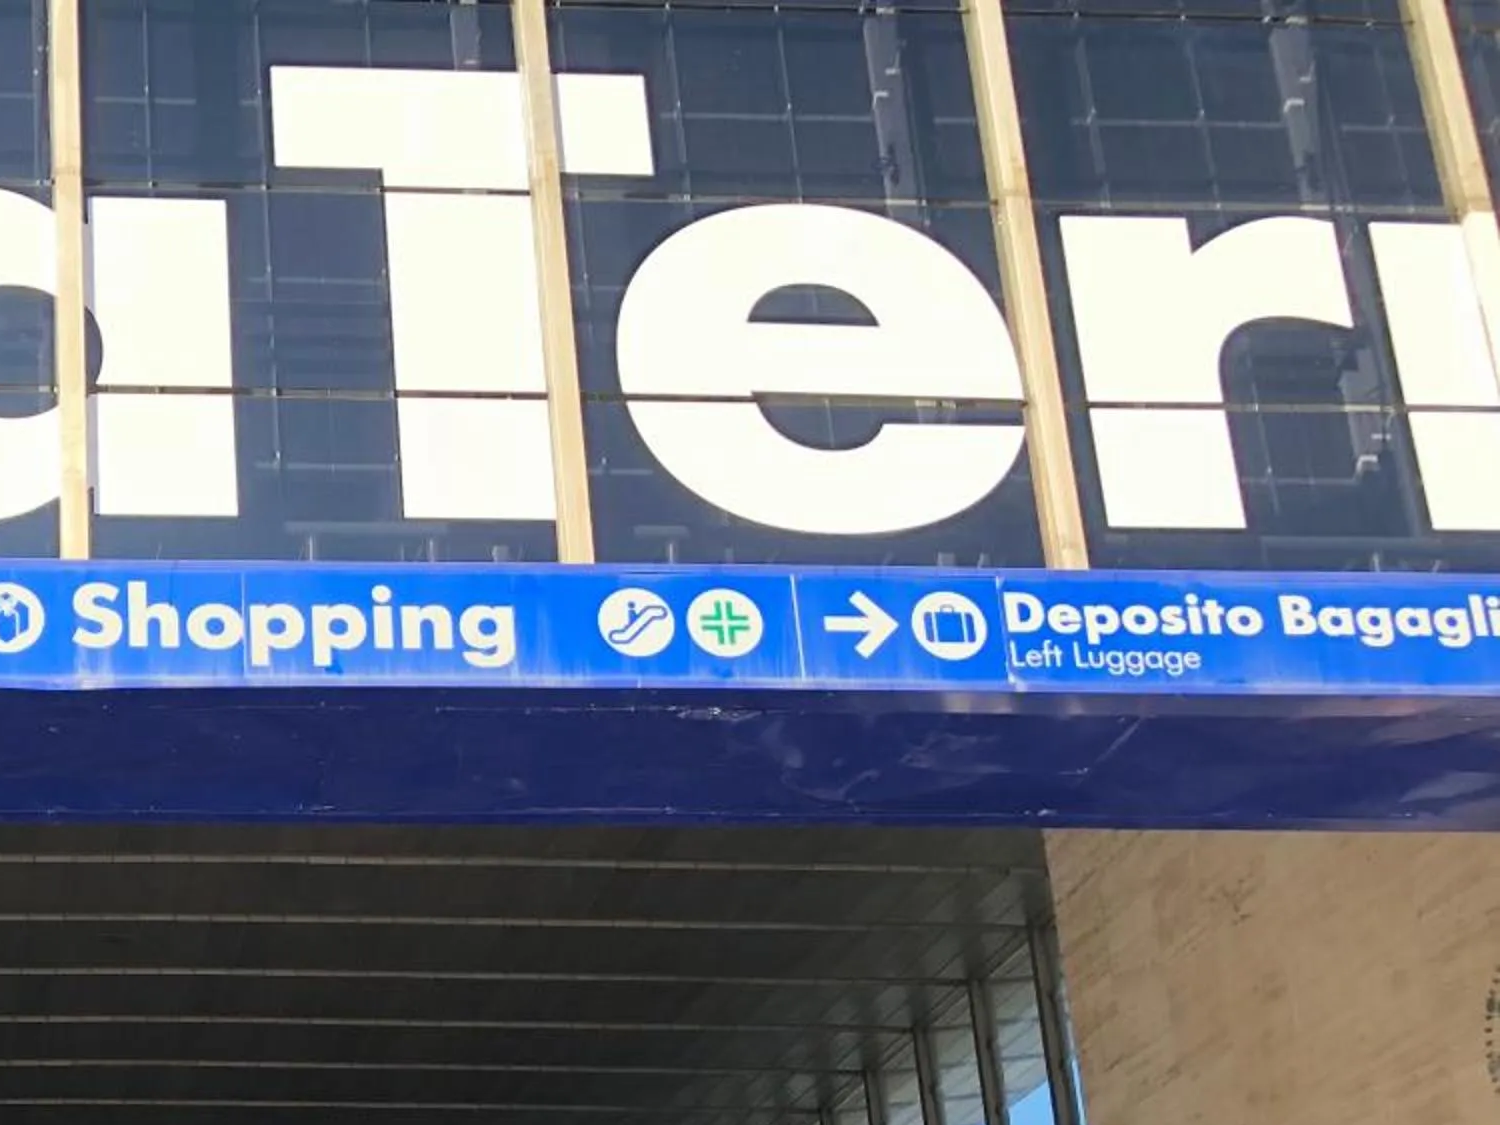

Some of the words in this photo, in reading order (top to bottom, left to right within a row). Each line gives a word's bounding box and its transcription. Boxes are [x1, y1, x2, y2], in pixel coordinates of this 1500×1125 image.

[72, 580, 517, 667] Shopping
[1003, 592, 1264, 645] Deposito
[1278, 595, 1500, 648] Bagagli
[1009, 641, 1062, 668] Left
[1073, 642, 1201, 676] Luggage
